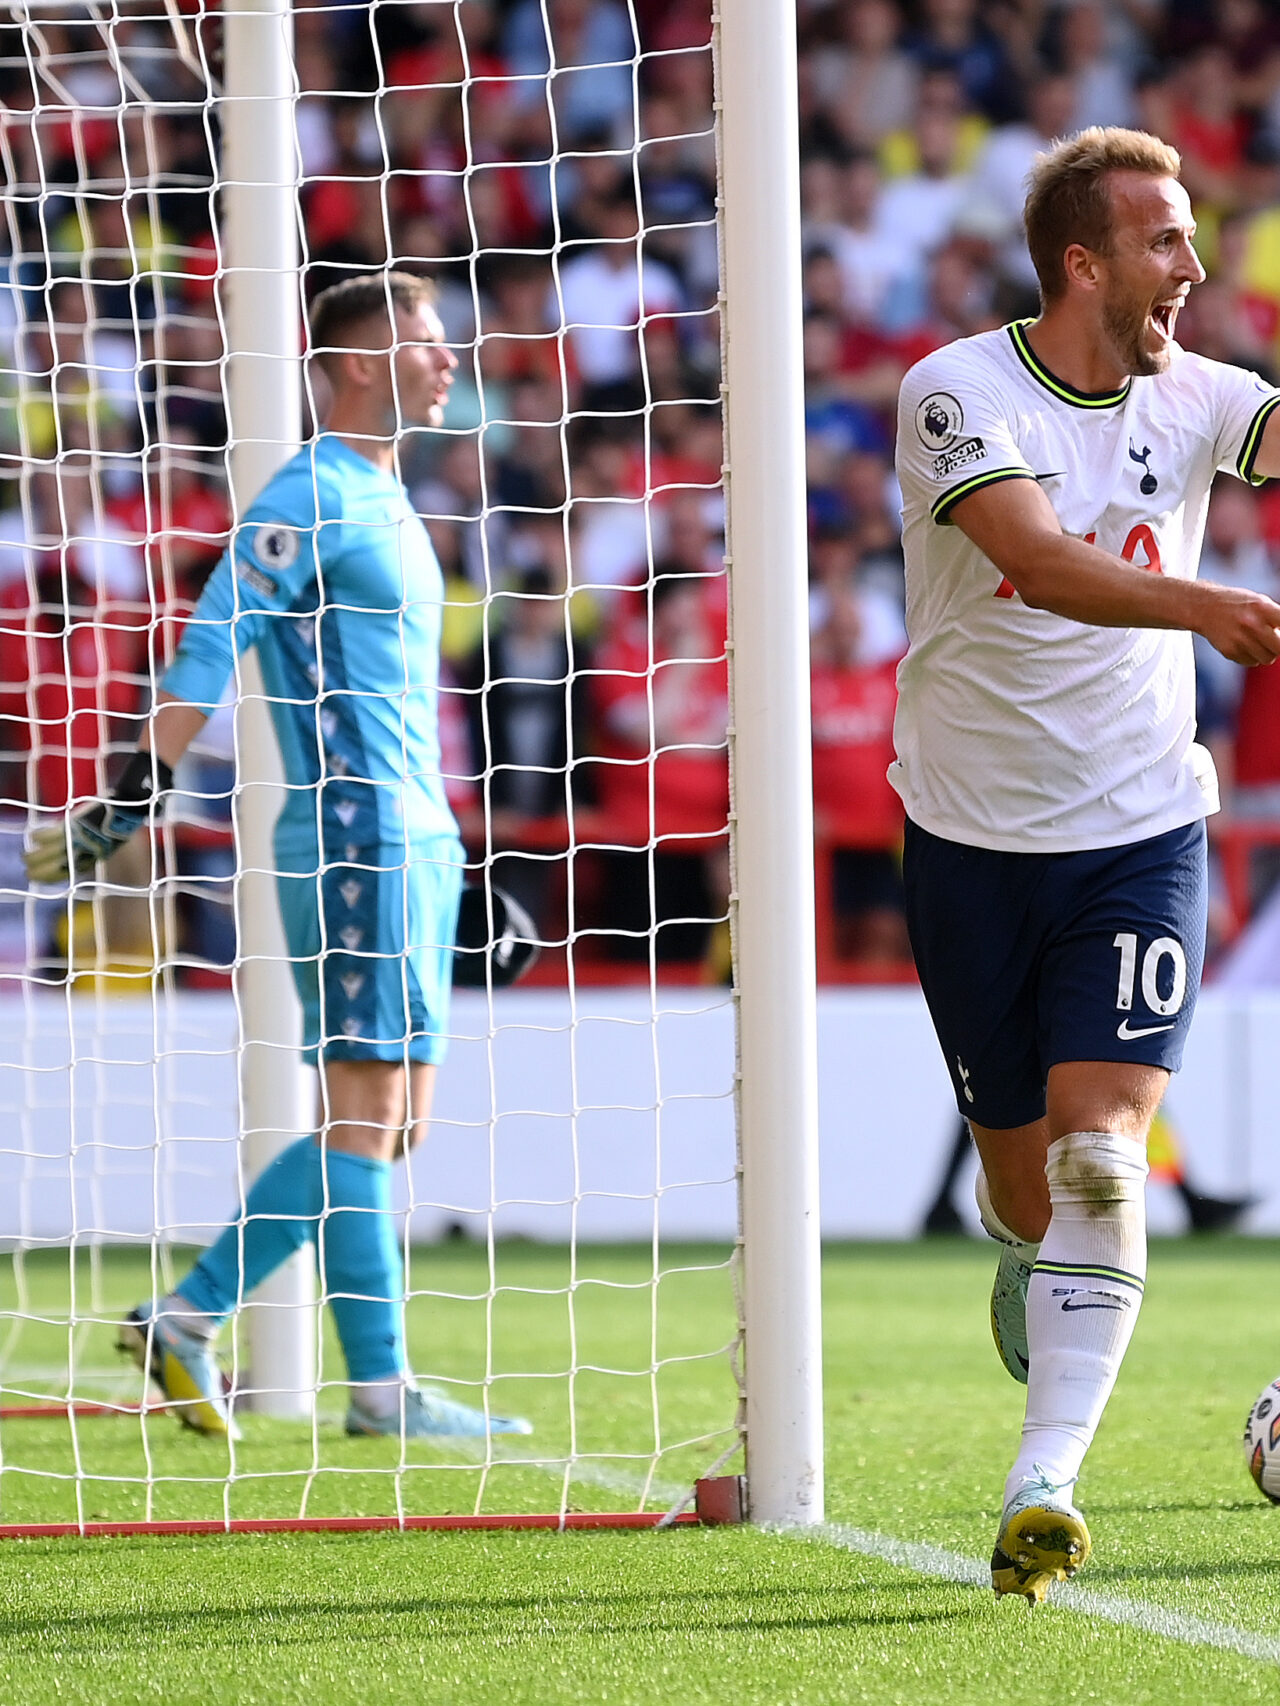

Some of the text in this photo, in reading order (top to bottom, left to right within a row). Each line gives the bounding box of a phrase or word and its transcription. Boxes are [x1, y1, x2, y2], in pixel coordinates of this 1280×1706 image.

[932, 440, 979, 470] No room
[1113, 932, 1187, 1016] 10
